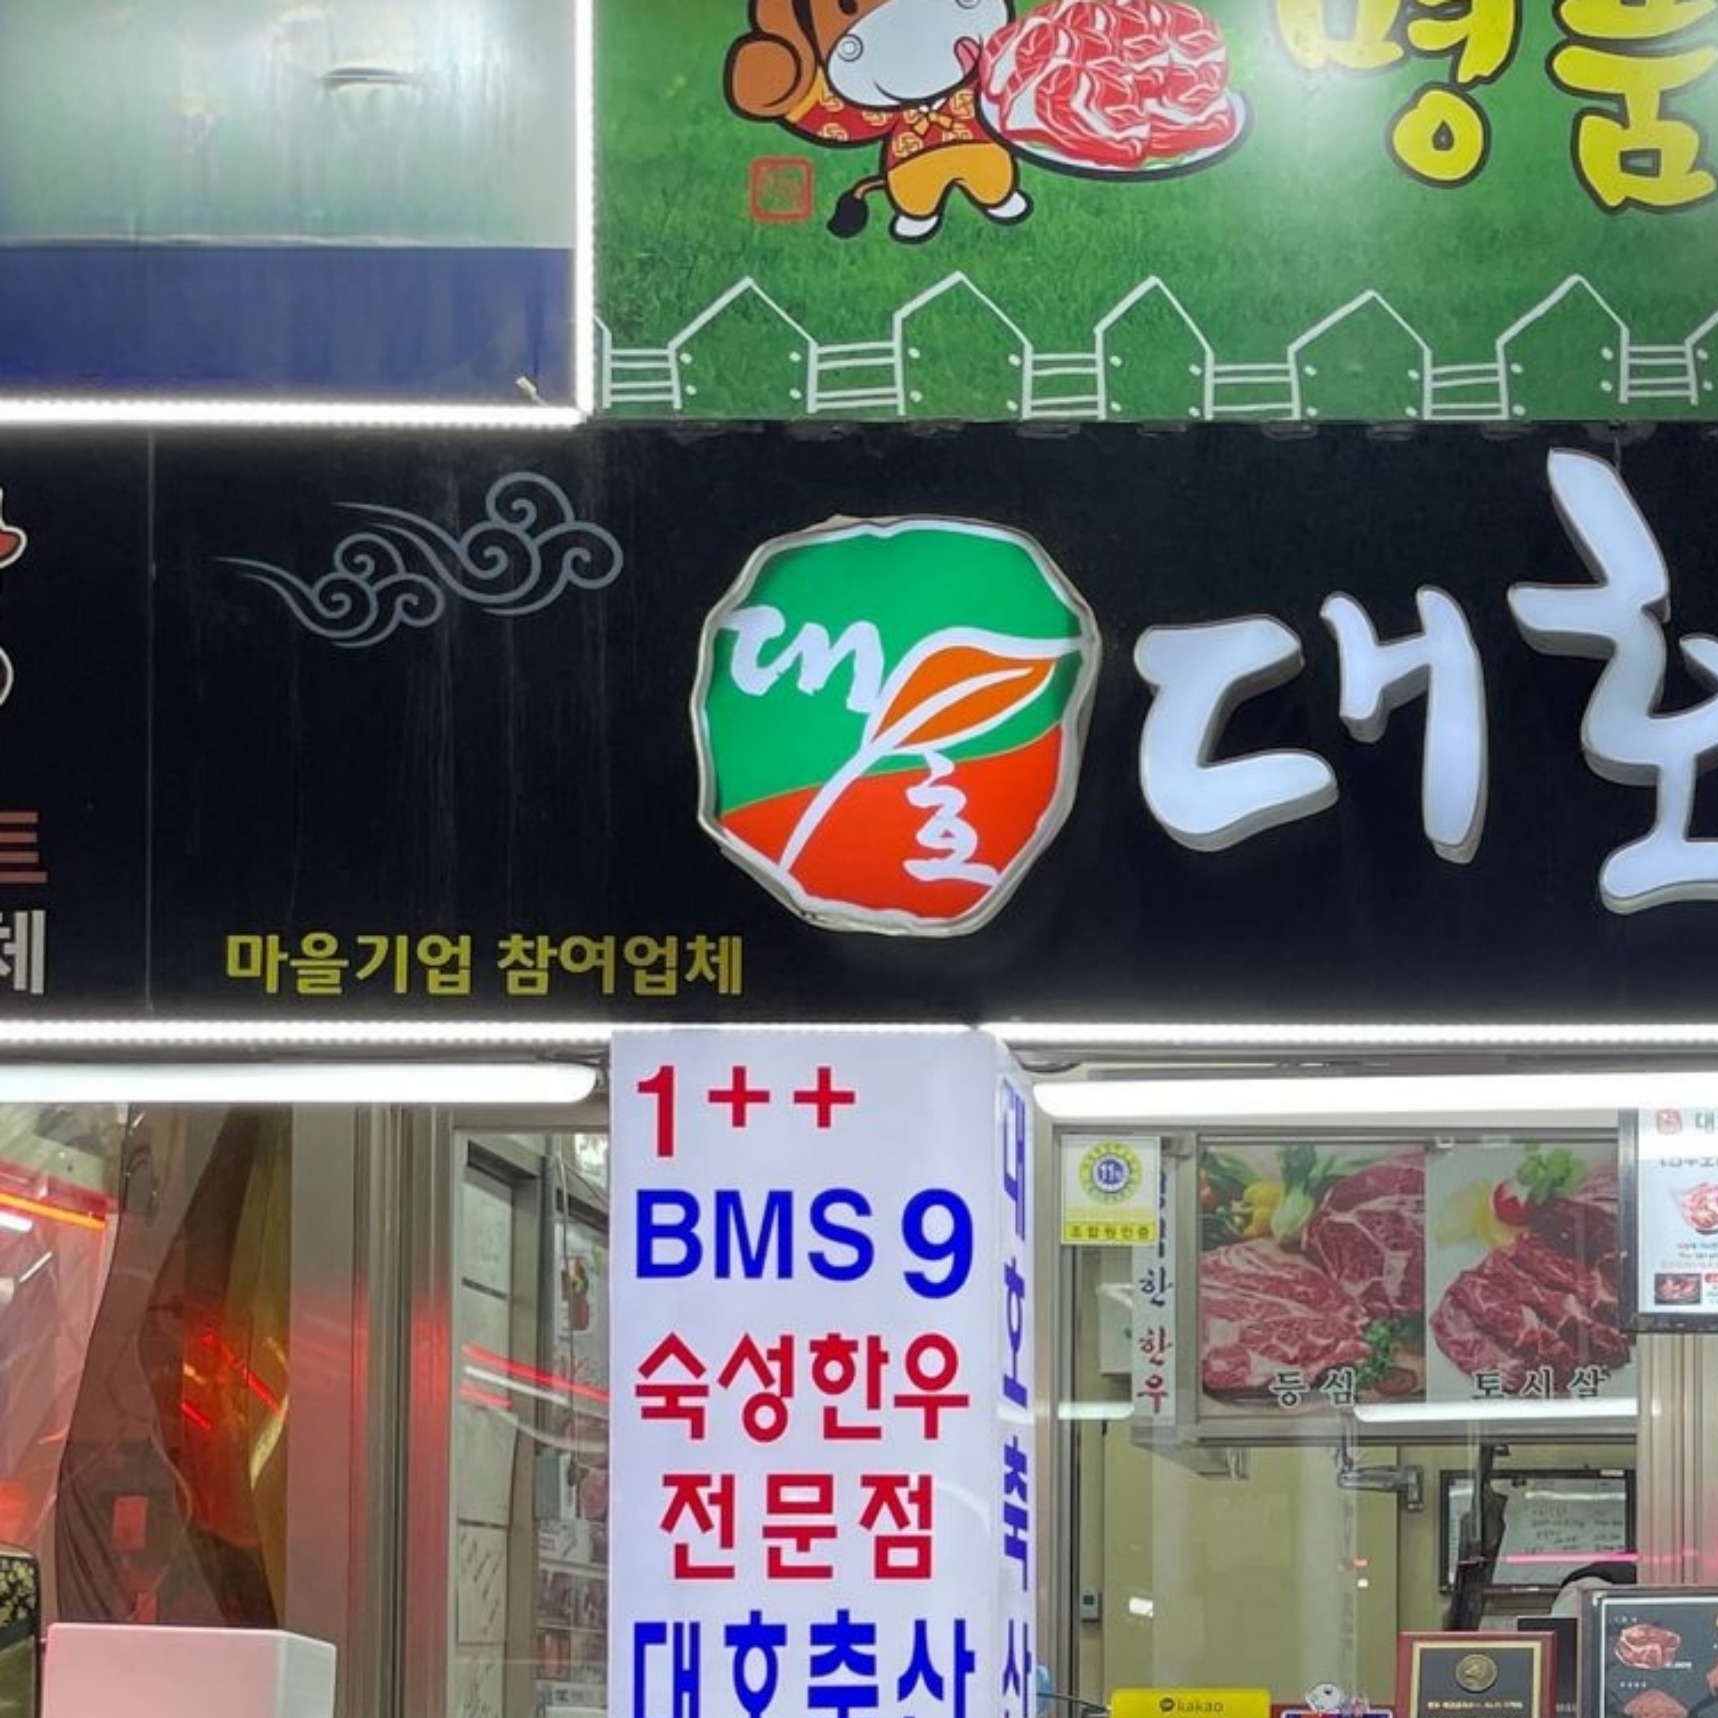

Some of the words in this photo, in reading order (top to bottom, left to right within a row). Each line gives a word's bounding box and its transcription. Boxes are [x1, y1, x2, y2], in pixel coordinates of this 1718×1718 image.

[226, 932, 471, 995] 마을기업
[498, 932, 745, 996] 참여업체
[636, 1064, 857, 1159] 1++
[635, 1187, 875, 1282] BMS
[901, 1187, 974, 1300] 9
[635, 1331, 971, 1443] 숙성한우
[1272, 1368, 1357, 1407] 등심
[659, 1472, 935, 1581] 전문점
[1176, 1699, 1226, 1714] kakao
